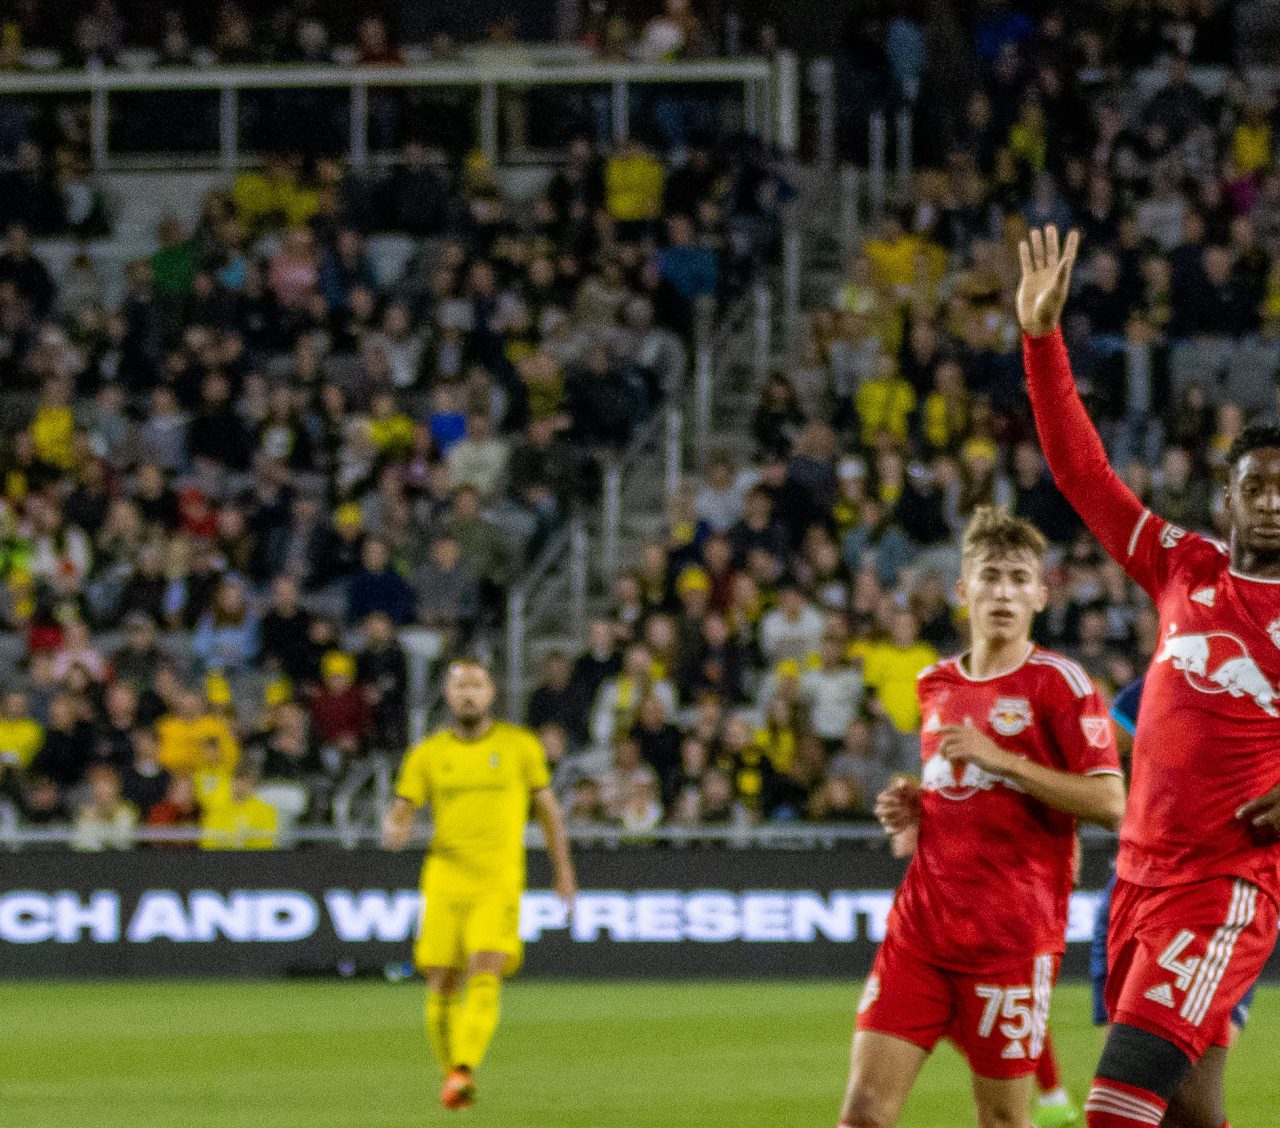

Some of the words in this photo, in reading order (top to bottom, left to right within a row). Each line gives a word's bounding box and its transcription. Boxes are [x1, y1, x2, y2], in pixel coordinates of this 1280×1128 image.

[126, 889, 320, 943] AND
[322, 888, 426, 943] W
[1157, 928, 1201, 992] 4
[975, 984, 1032, 1039] 75
